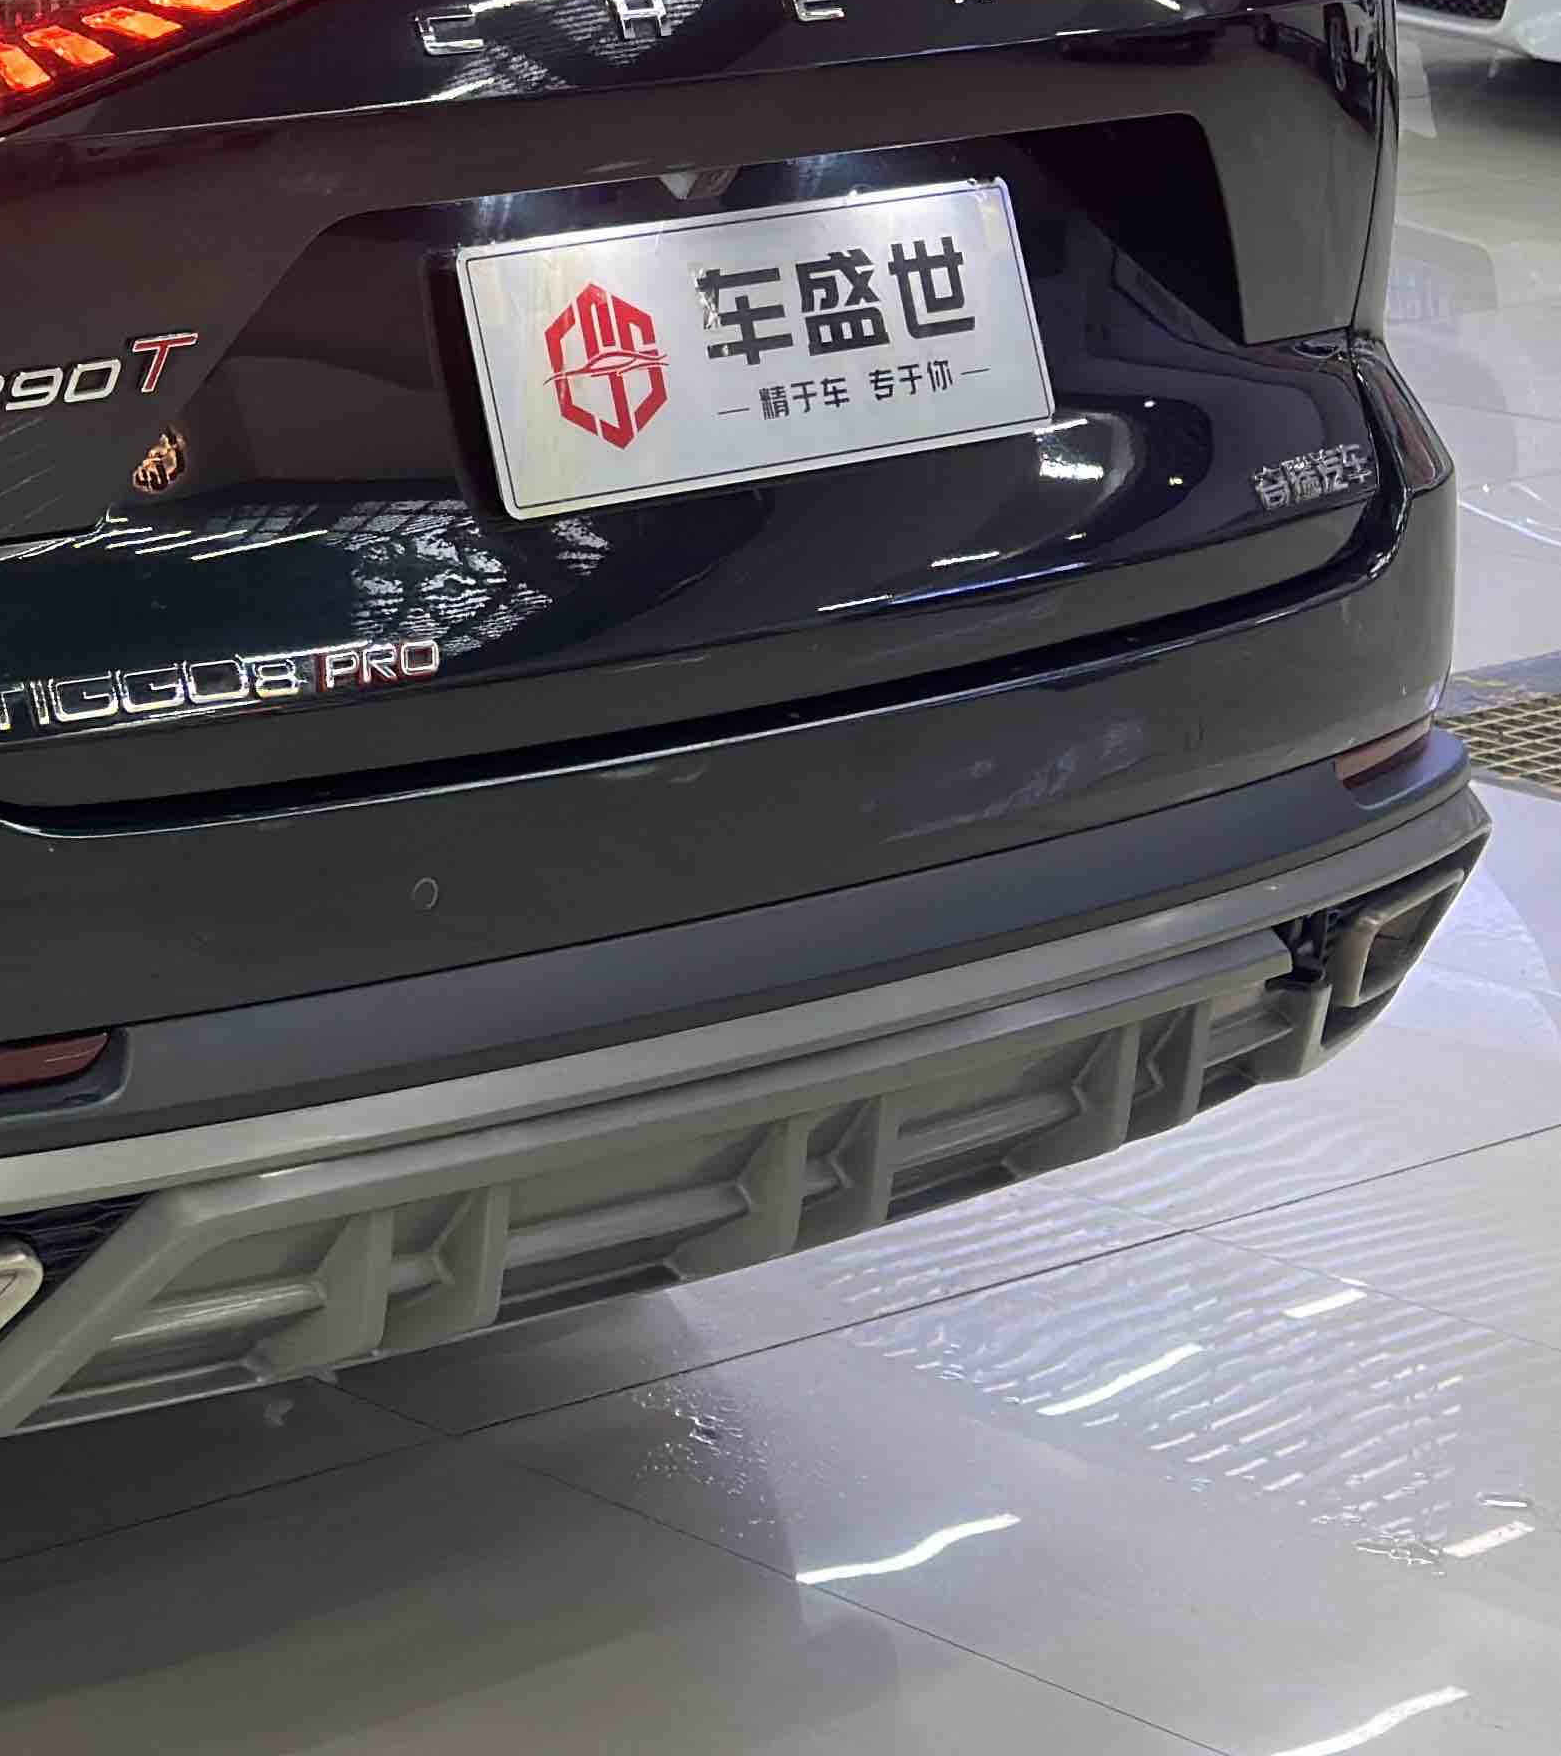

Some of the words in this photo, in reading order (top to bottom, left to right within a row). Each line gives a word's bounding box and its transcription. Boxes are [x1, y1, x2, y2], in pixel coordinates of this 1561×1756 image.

[695, 236, 977, 366] 车盛世
[758, 374, 850, 420] 精于车
[868, 360, 955, 400] 专于你
[323, 639, 440, 690] PRO
